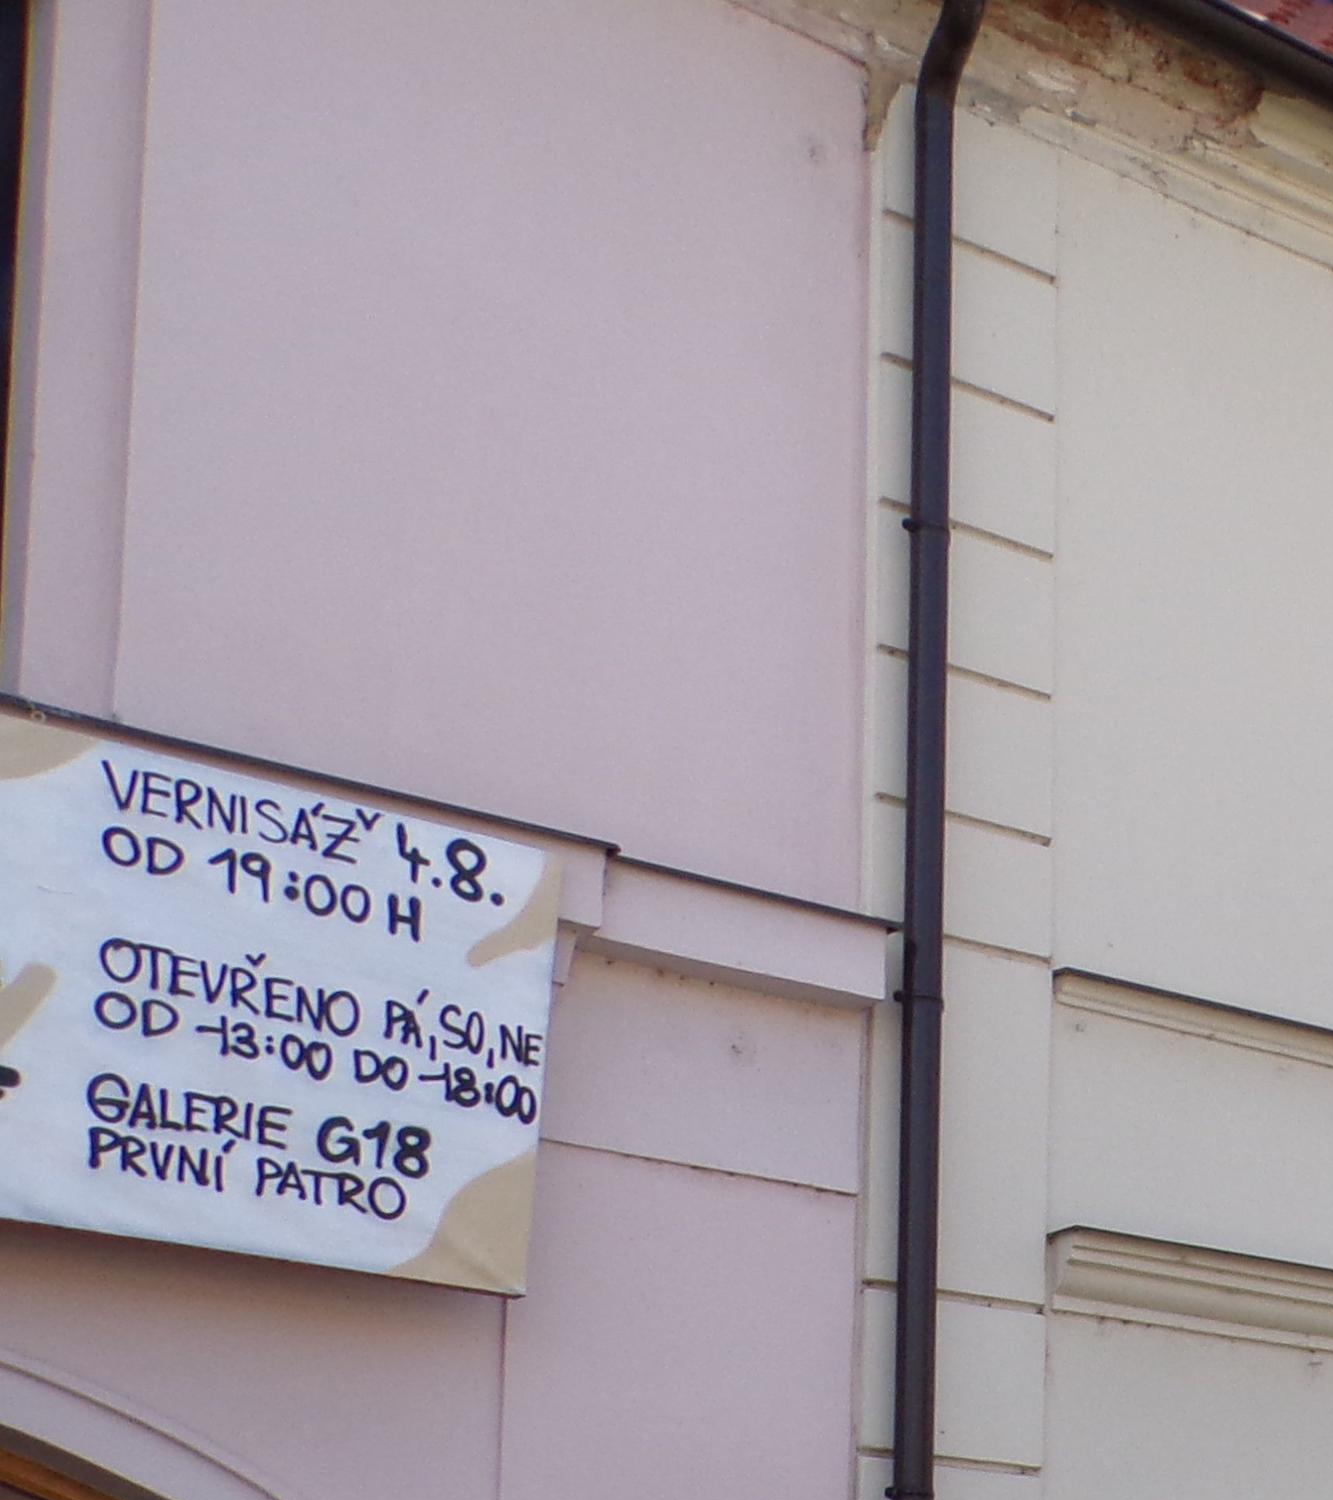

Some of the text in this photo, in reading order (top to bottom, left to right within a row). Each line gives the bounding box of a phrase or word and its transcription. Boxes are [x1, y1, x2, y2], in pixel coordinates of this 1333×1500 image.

[103, 761, 505, 906] VERNISÁŽ 4.8.
[103, 826, 422, 941] OD 19:00 H
[100, 938, 360, 1036] OTEVŘENO
[95, 992, 179, 1035] OD
[355, 1049, 408, 1090] DO
[87, 1073, 432, 1178] GALERIE G18
[88, 1128, 406, 1220] PRVNÍ PATRO
